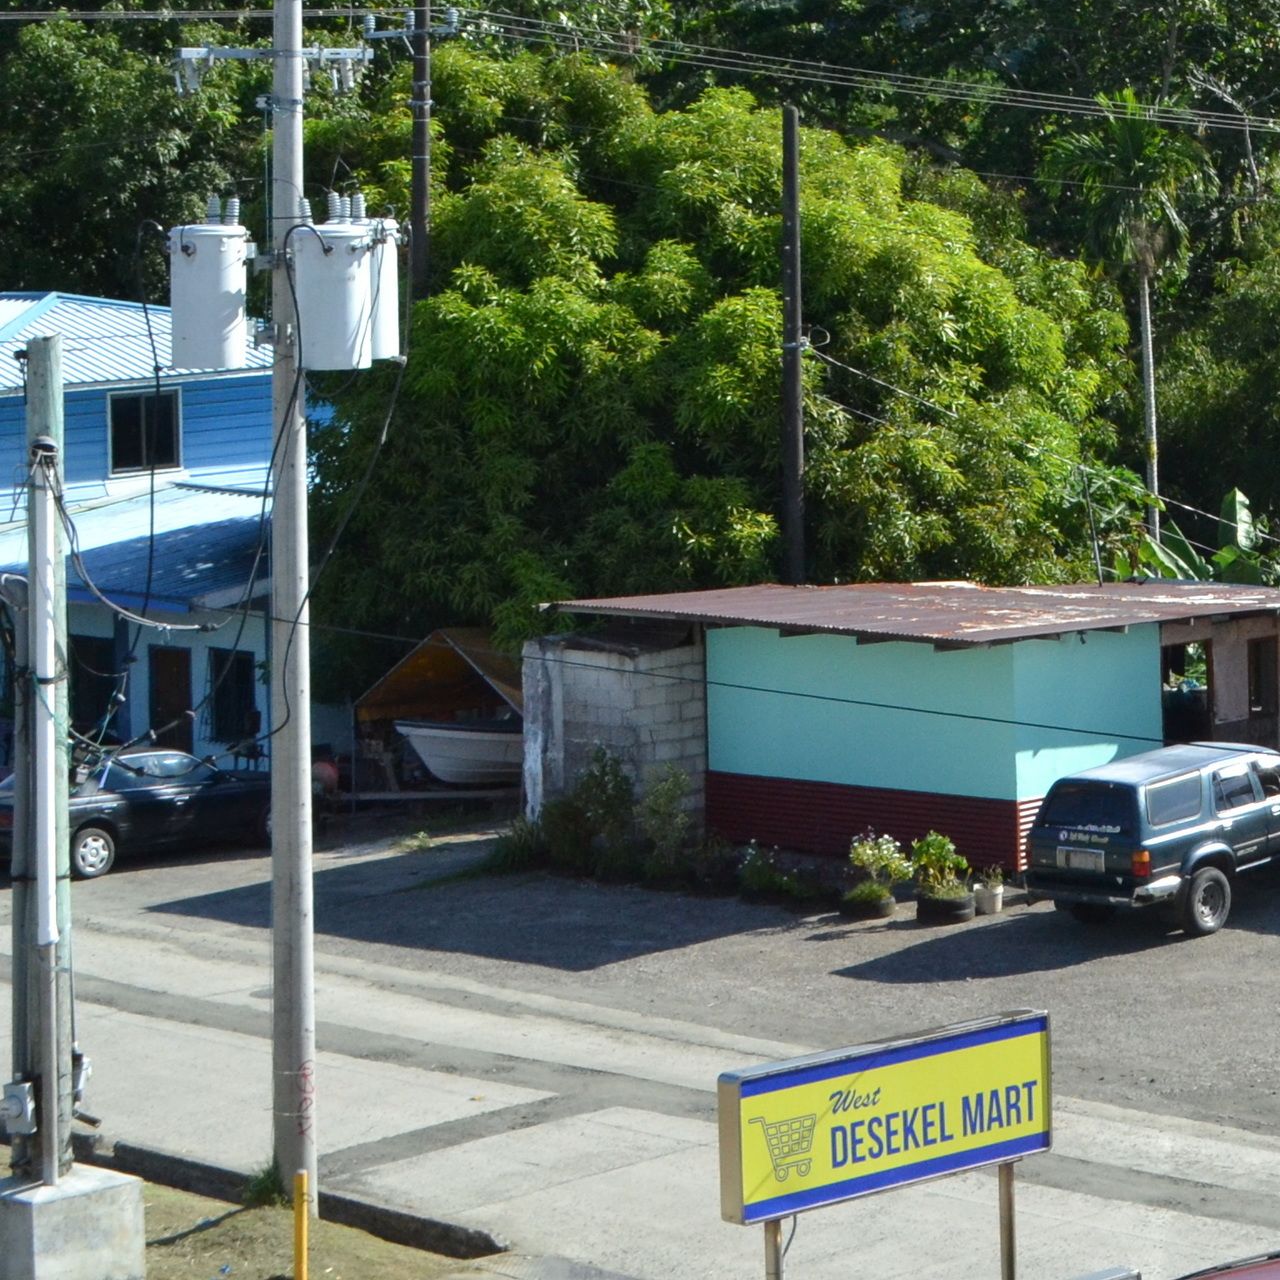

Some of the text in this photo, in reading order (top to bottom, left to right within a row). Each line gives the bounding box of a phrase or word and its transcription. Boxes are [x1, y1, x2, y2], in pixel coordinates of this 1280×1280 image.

[829, 1087, 881, 1114] West
[831, 1080, 1038, 1169] DESEKEL MART
